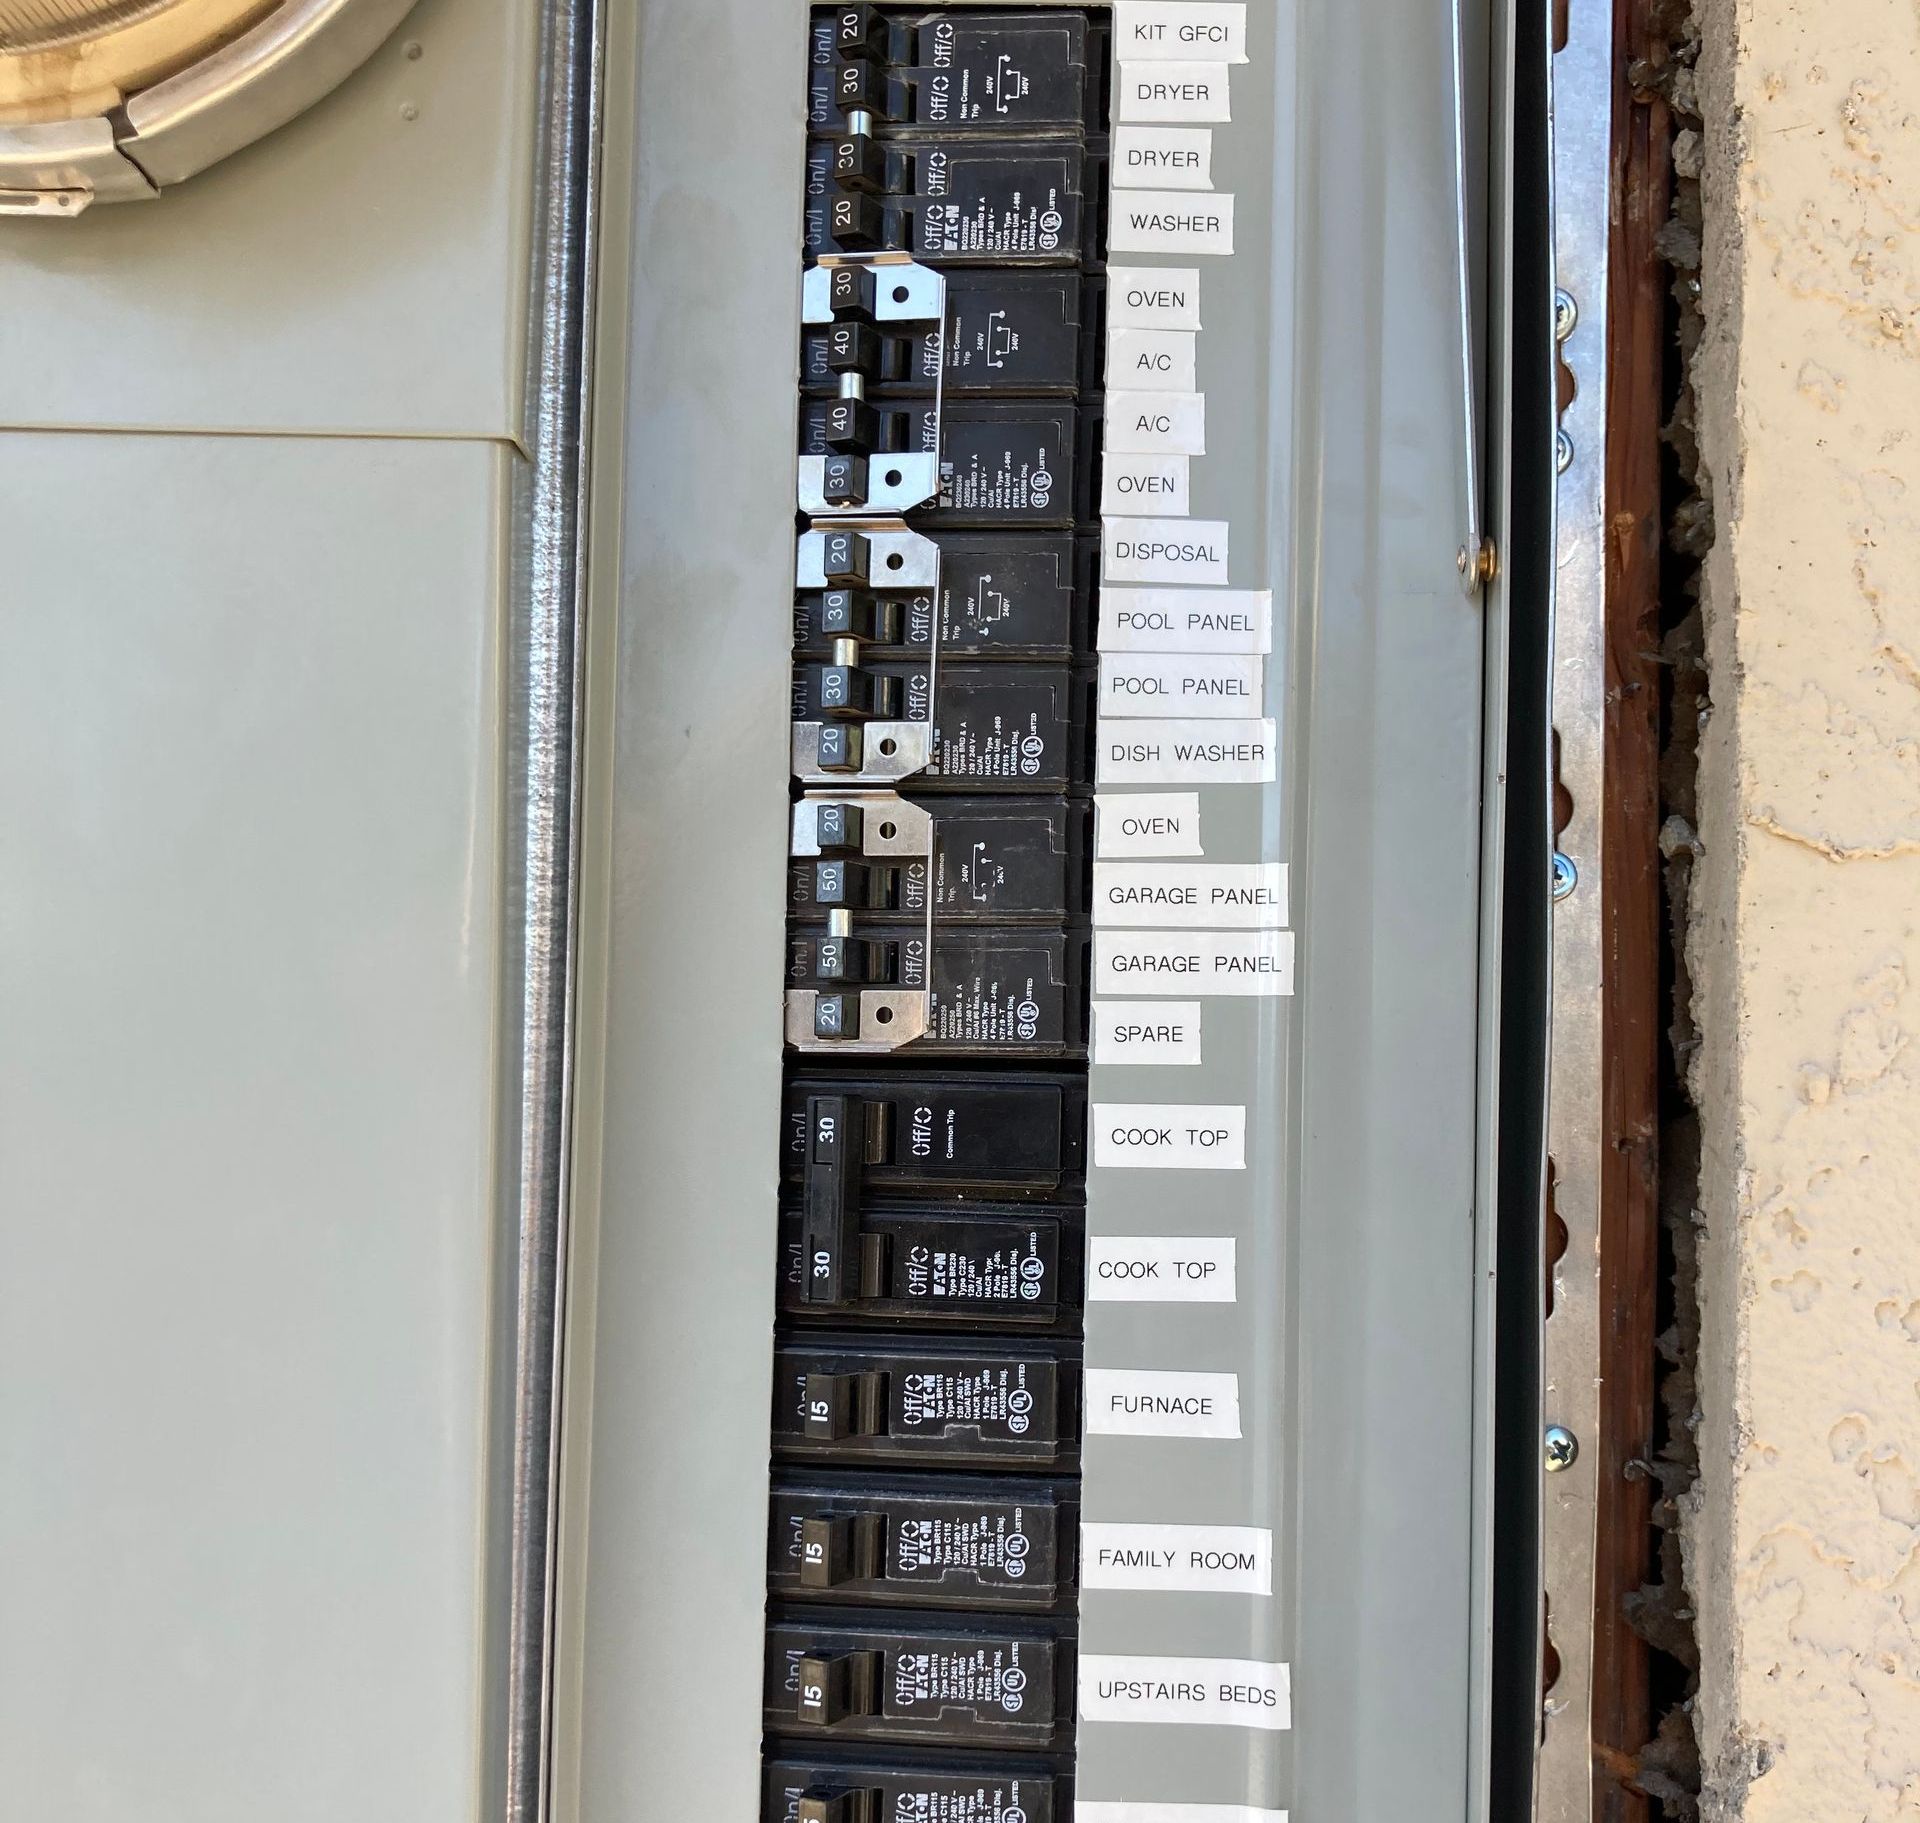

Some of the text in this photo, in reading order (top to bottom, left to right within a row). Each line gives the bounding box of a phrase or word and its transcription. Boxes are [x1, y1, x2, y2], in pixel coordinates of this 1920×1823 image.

[843, 14, 857, 38] 20
[1136, 25, 1227, 42] KIT GFCI
[934, 23, 953, 68] Off/O
[843, 69, 858, 93] 30
[930, 75, 948, 121] Off/O
[1139, 85, 1208, 100] DRYER
[839, 144, 853, 168] 30
[1129, 150, 1198, 167] DRYER
[928, 152, 947, 196] Off/O
[836, 201, 850, 225] 20
[1131, 214, 1218, 232] WASHER
[925, 205, 943, 250] Off/O
[837, 273, 851, 295] 30
[1128, 291, 1184, 307] OVEN
[835, 331, 849, 354] 40
[1137, 354, 1171, 370] A/C
[833, 408, 847, 430] 40
[1136, 416, 1169, 432] A/C
[830, 465, 844, 488] 30
[1118, 477, 1174, 493] OVEN
[831, 539, 846, 563] 20
[1117, 542, 1219, 561] DISPOSAL
[828, 595, 842, 620] 30
[912, 596, 929, 642] Off/O
[1118, 613, 1254, 631] POOL PANEL
[826, 675, 841, 698] 30
[909, 675, 927, 720] Off/O
[1114, 678, 1249, 695] POOL PANEL
[823, 729, 838, 753] 20
[1112, 745, 1264, 761] DISH WASHER
[824, 810, 838, 831] 20
[1123, 818, 1179, 835] OVEN
[823, 869, 836, 890] 50
[907, 863, 924, 908] Off/O
[1109, 888, 1277, 904] GARAGE PANEL
[823, 945, 836, 967] 50
[905, 940, 923, 984] Off/O
[1112, 956, 1281, 972] GARAGE PANEL
[821, 1004, 835, 1025] 20
[1114, 1026, 1182, 1042] SPARE
[819, 1118, 834, 1143] 30
[912, 1107, 932, 1156] Off/O
[1112, 1129, 1228, 1146] COOK TOP
[814, 1252, 829, 1278] 30
[1099, 1262, 1215, 1279] COOK TOP
[904, 1374, 923, 1424] Off/O
[1112, 1396, 1212, 1414] FURNACE
[811, 1402, 828, 1421] 15
[806, 1544, 822, 1563] 15
[899, 1521, 919, 1571] Off/O
[1100, 1550, 1254, 1570] FAMILY ROOM
[896, 1654, 916, 1705] Off/O
[804, 1686, 821, 1707] 15
[1099, 1682, 1276, 1706] UPSTAIRS BEDS
